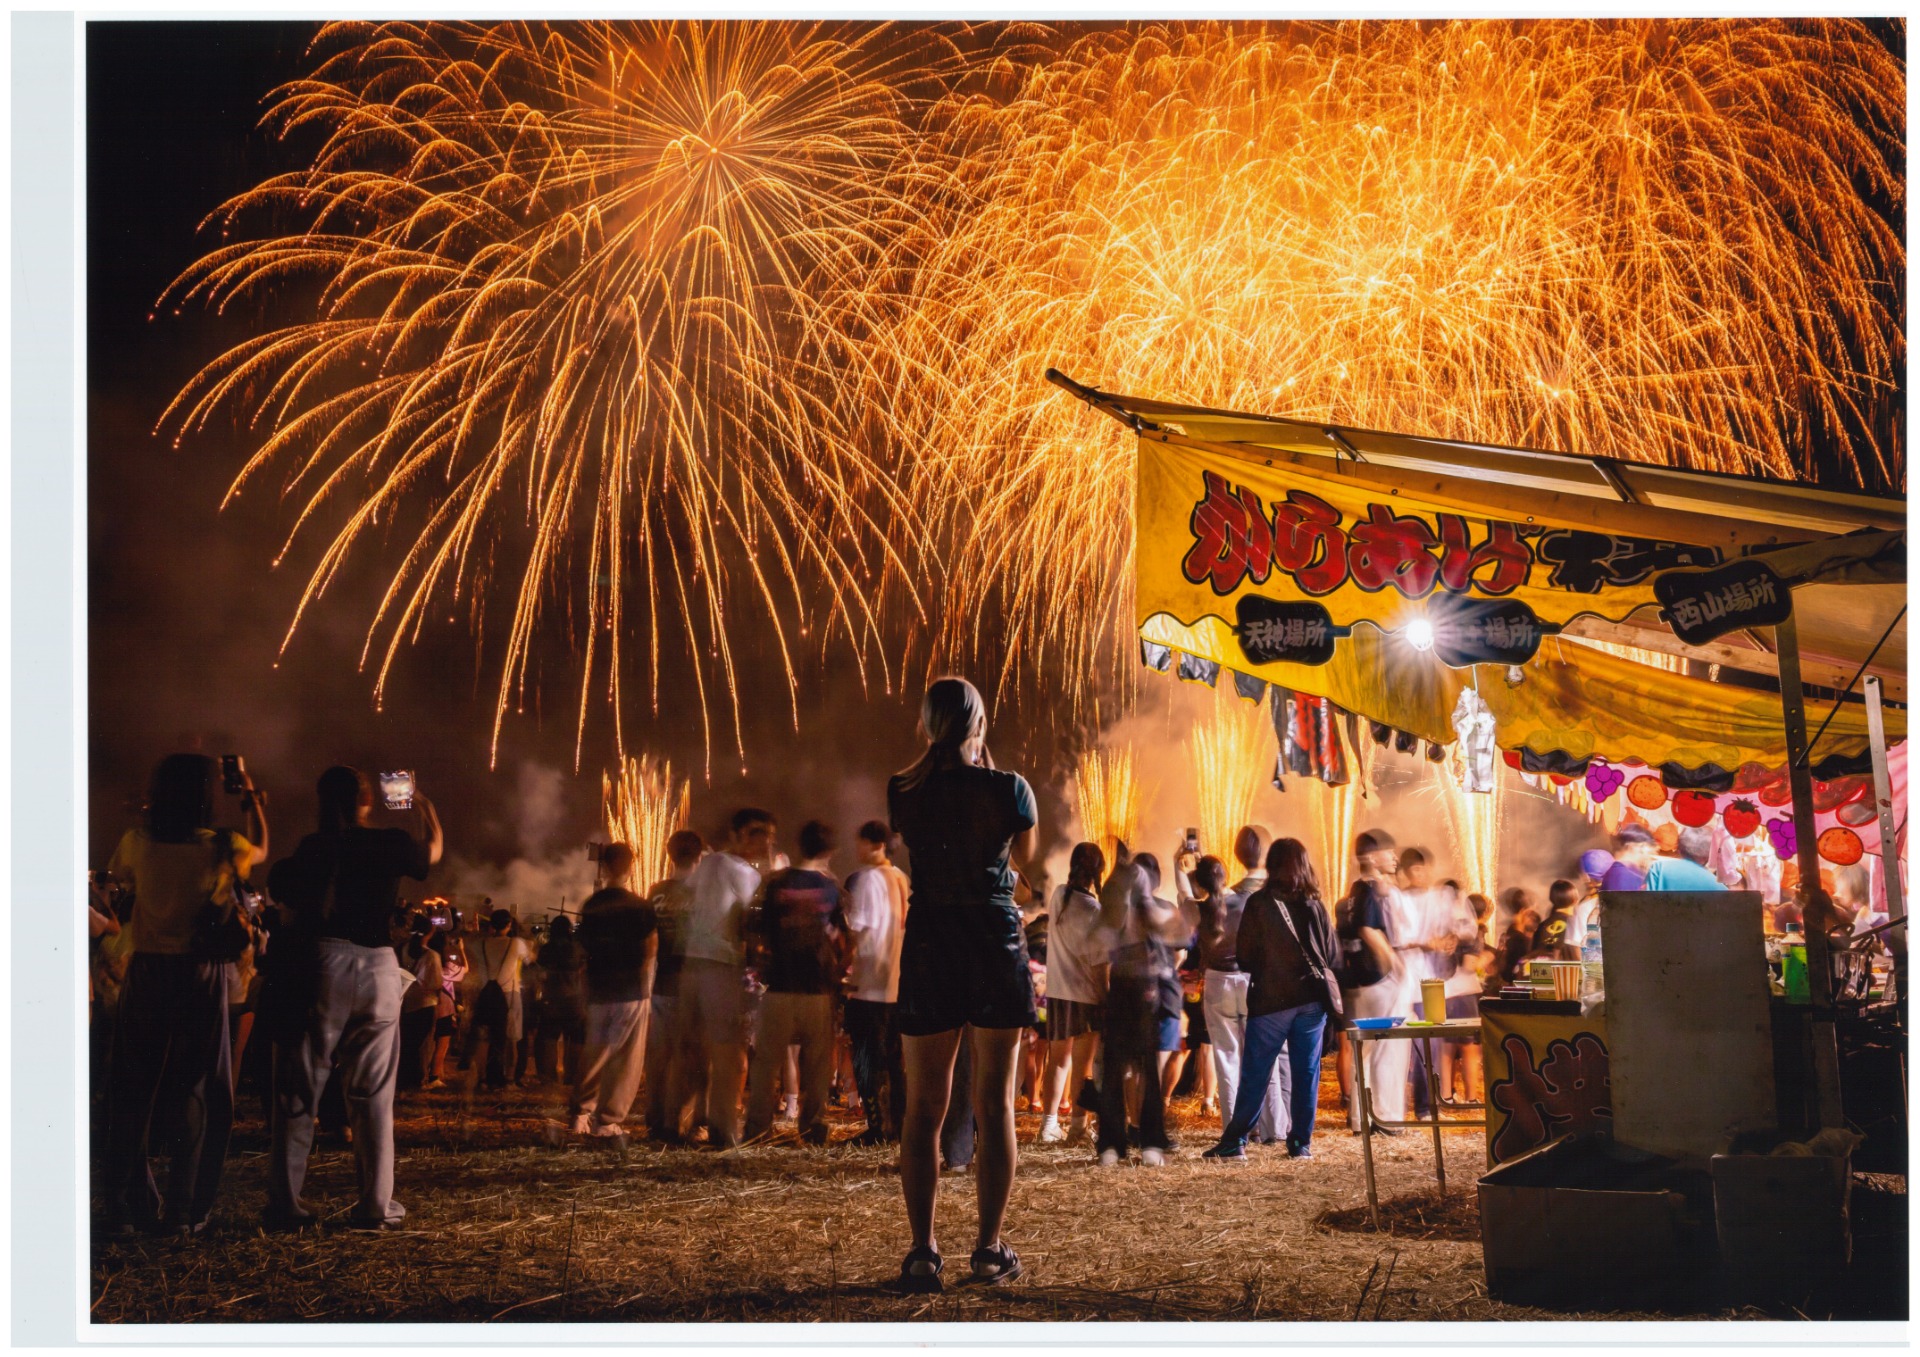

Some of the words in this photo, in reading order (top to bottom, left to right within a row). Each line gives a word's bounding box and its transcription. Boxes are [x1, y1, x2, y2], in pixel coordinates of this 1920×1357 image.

[1182, 470, 1545, 597] からあげ
[1671, 573, 1777, 631] 西山場所
[1243, 616, 1327, 650] 天神場所
